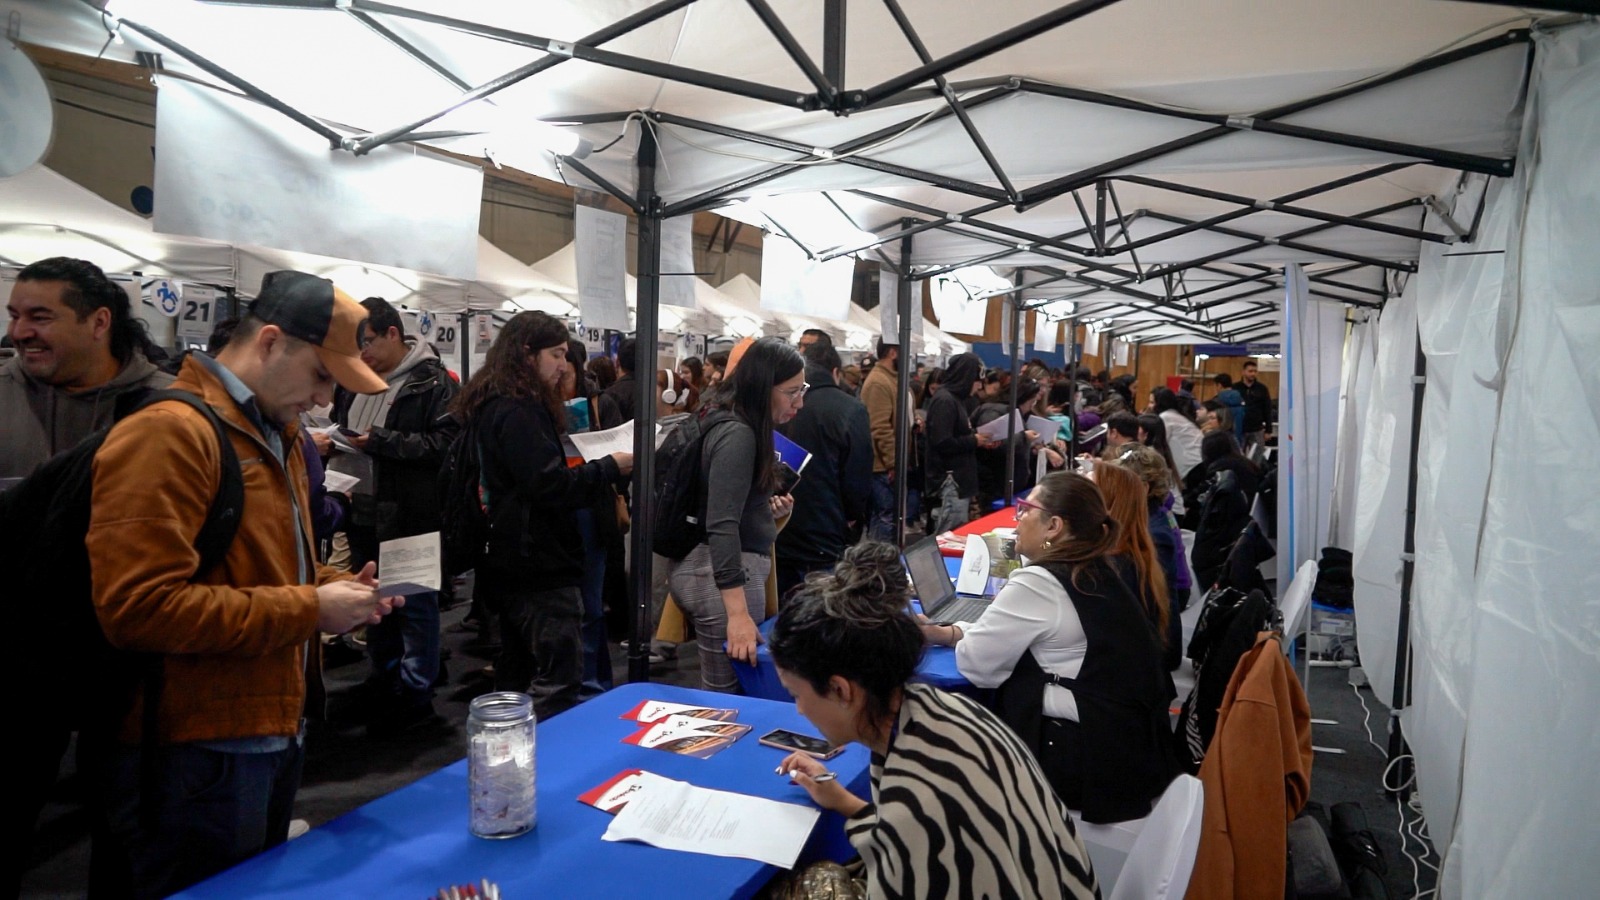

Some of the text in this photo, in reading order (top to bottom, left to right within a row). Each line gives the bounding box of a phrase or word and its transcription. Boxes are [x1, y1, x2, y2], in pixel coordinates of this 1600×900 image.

[184, 300, 210, 322] 21
[437, 326, 455, 342] 20
[588, 329, 599, 342] 19
[695, 343, 704, 355] 18
